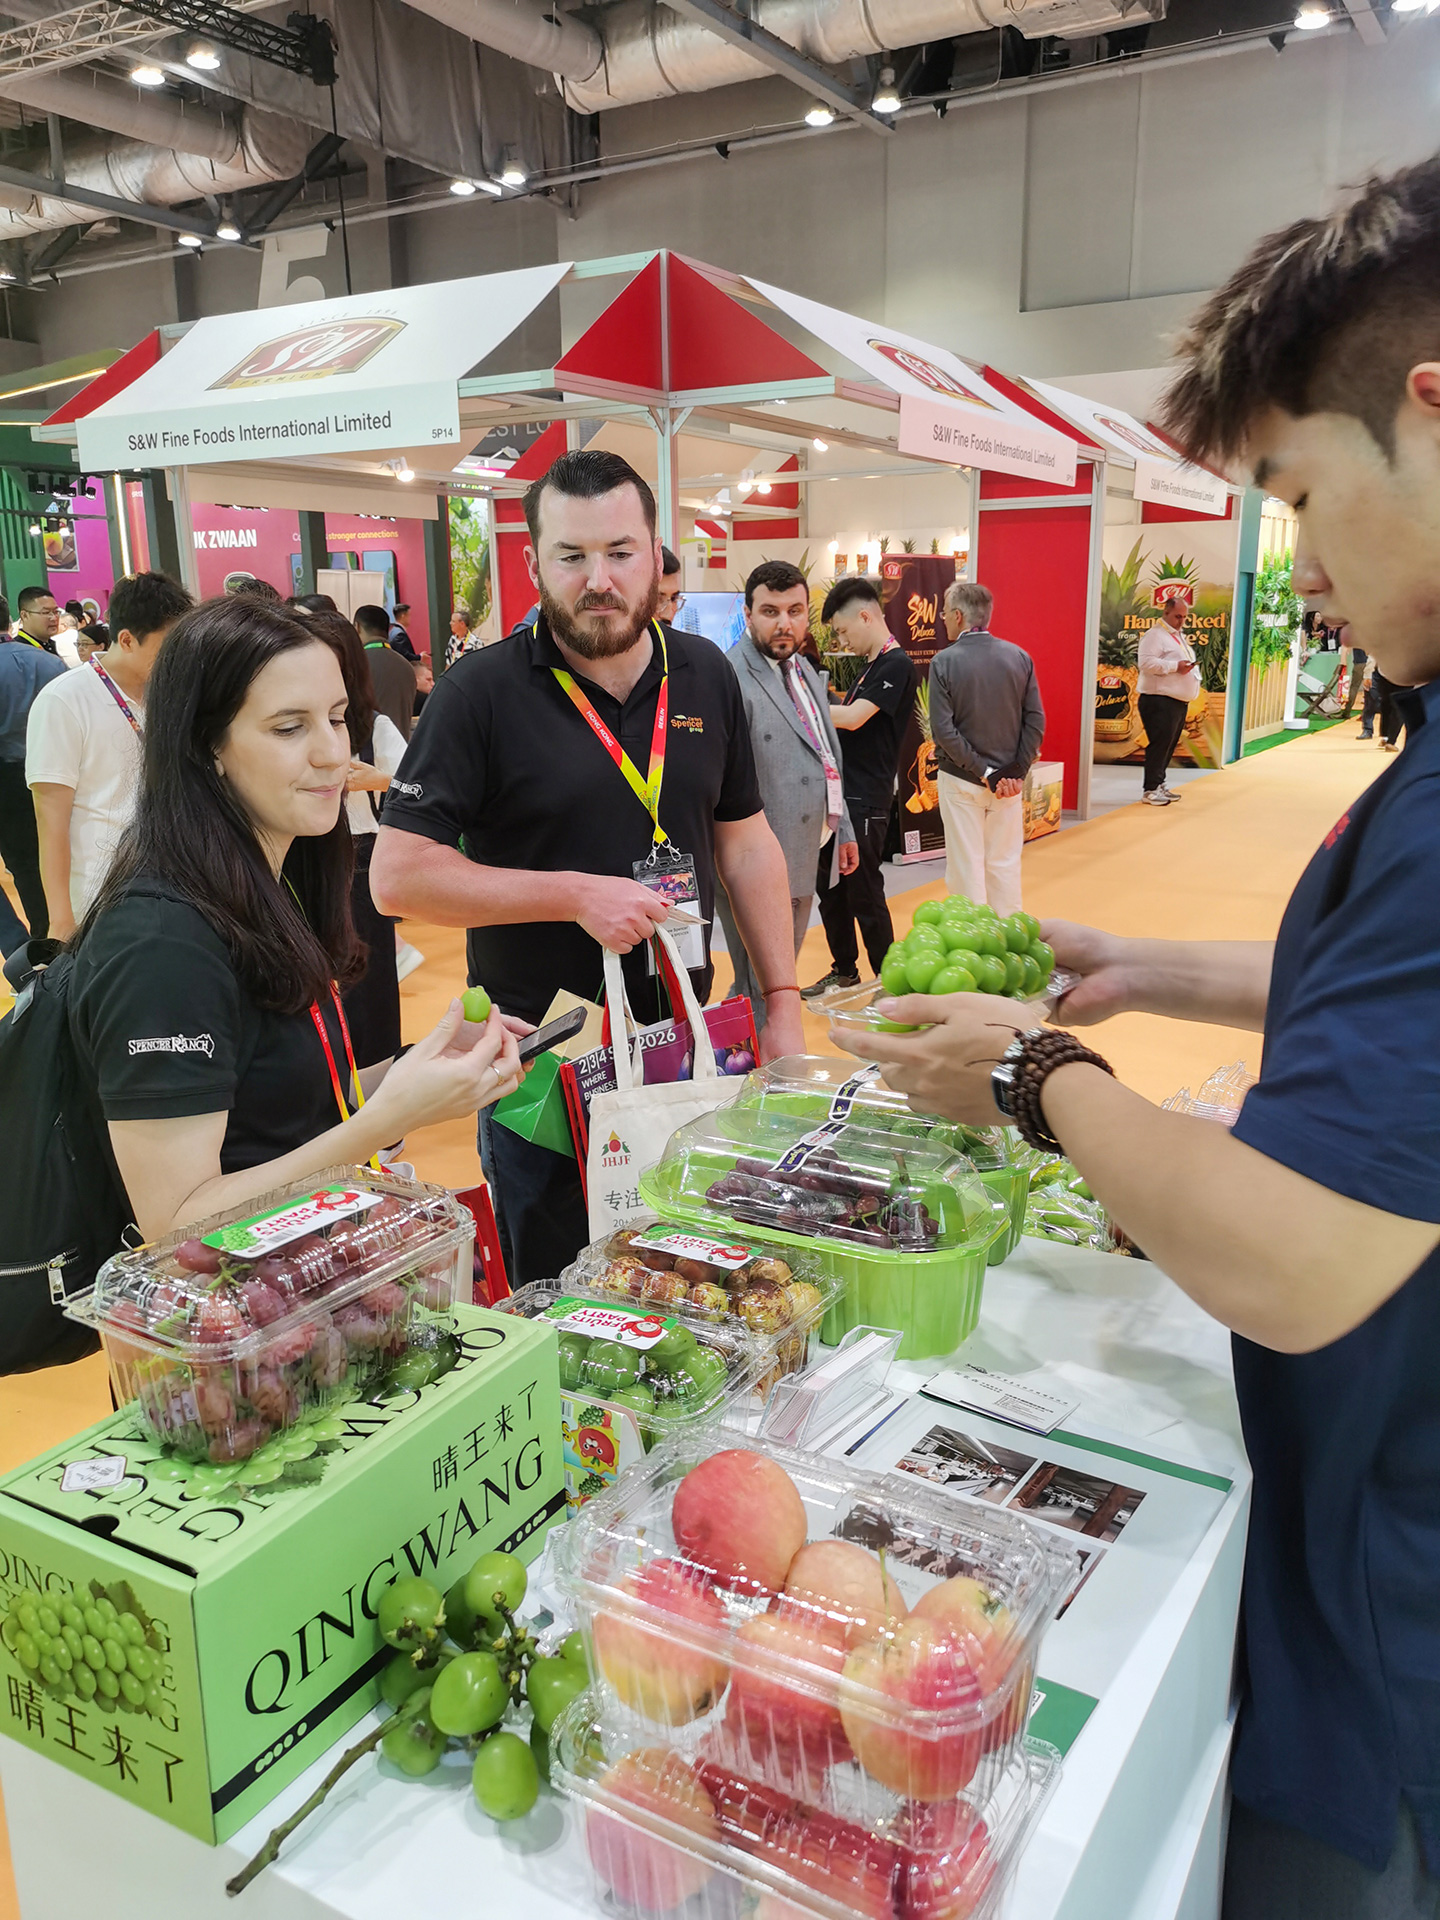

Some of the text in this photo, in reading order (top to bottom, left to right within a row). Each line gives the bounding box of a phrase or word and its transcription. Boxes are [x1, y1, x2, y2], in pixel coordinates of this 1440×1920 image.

[128, 410, 392, 451] S&W Fine Foods International Limited
[431, 428, 454, 439] 5P14
[932, 424, 1056, 468] S&W Fine Foods International Limited
[208, 528, 258, 549] ZWAAN
[328, 530, 399, 542] stronger connections
[907, 593, 938, 626] S&W
[910, 624, 936, 641] Deluxe
[1118, 630, 1137, 640] from
[586, 710, 615, 748] HONG KONG
[670, 718, 703, 731] Spencer
[640, 1028, 677, 1051] 2026
[581, 1070, 607, 1089] WHERE
[584, 1080, 618, 1101] BUSINESS
[602, 1155, 632, 1168] JHJF
[603, 1187, 645, 1212] 专注
[254, 1207, 311, 1232] PARTY
[260, 1210, 321, 1236] FRUITS
[613, 1218, 629, 1228] 20+
[671, 1235, 717, 1248] PARTY
[569, 1314, 621, 1328] FRUITS
[578, 1309, 628, 1322] PARTY
[432, 1380, 538, 1492] 晴王来了
[245, 1434, 545, 1716] QINGWANG
[7, 1674, 184, 1803] 晴王来了
